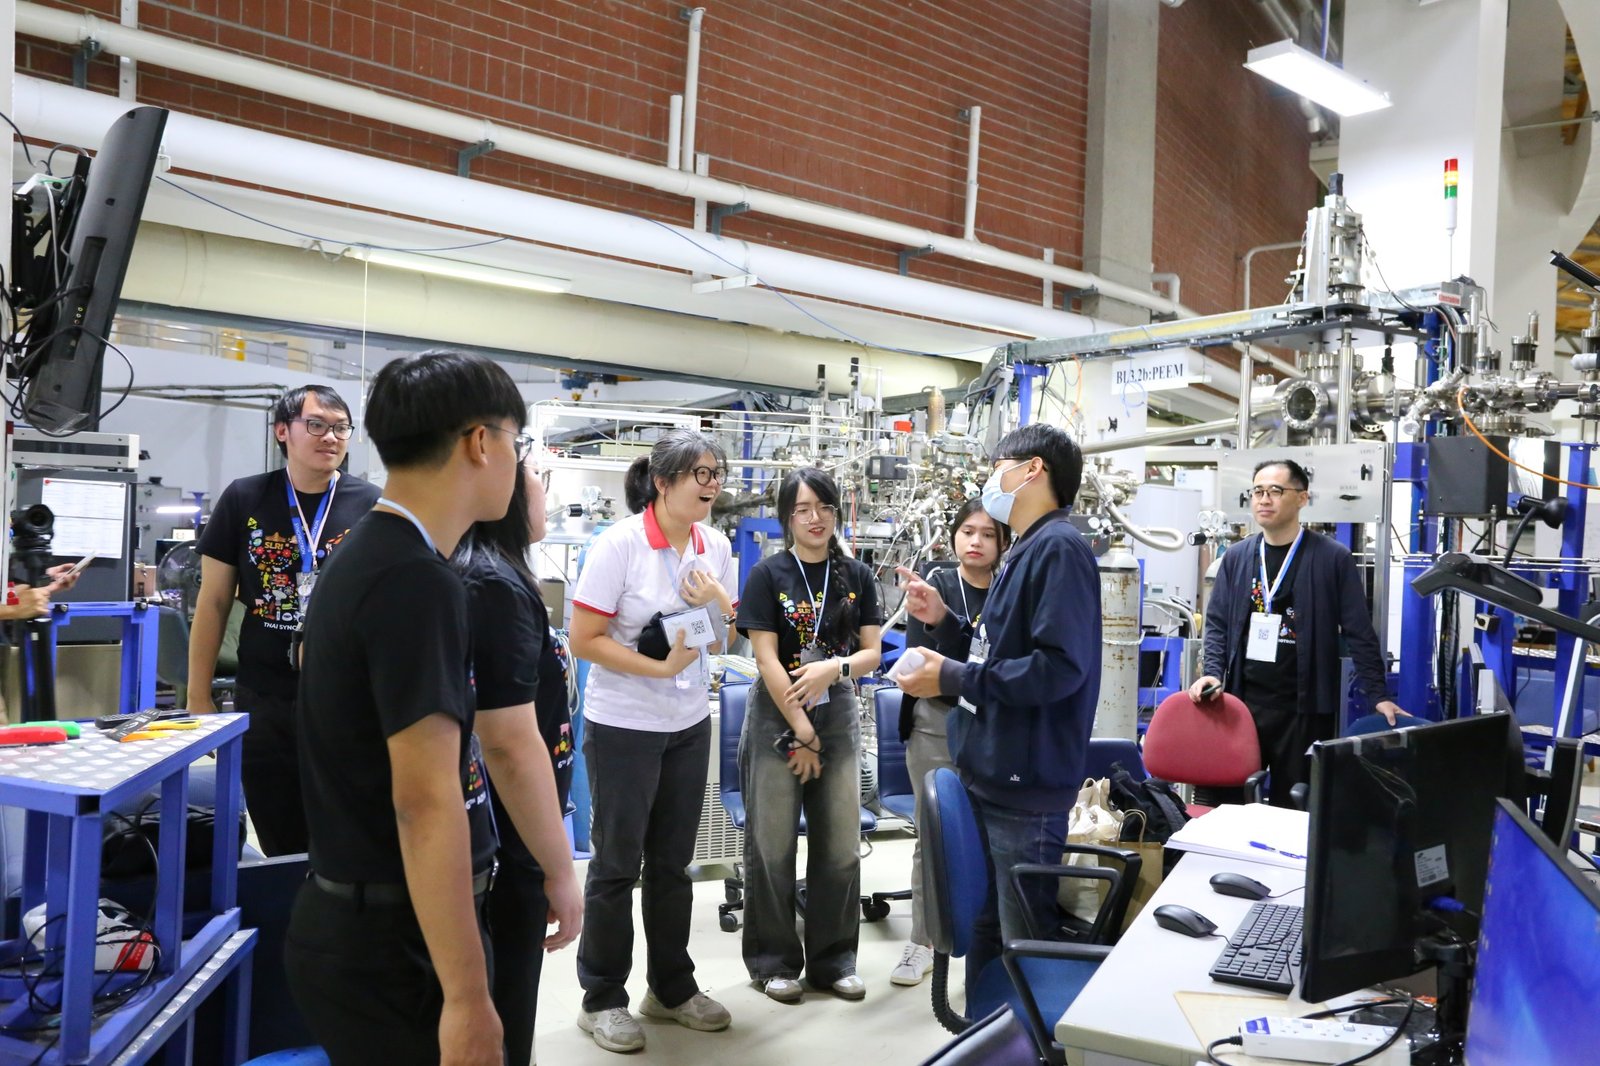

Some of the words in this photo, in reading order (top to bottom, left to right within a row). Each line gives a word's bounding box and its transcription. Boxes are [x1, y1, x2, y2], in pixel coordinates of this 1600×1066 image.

[1116, 363, 1184, 384] BL3.2b:PEEM
[264, 541, 284, 550] SLRI
[263, 621, 279, 630] THAI
